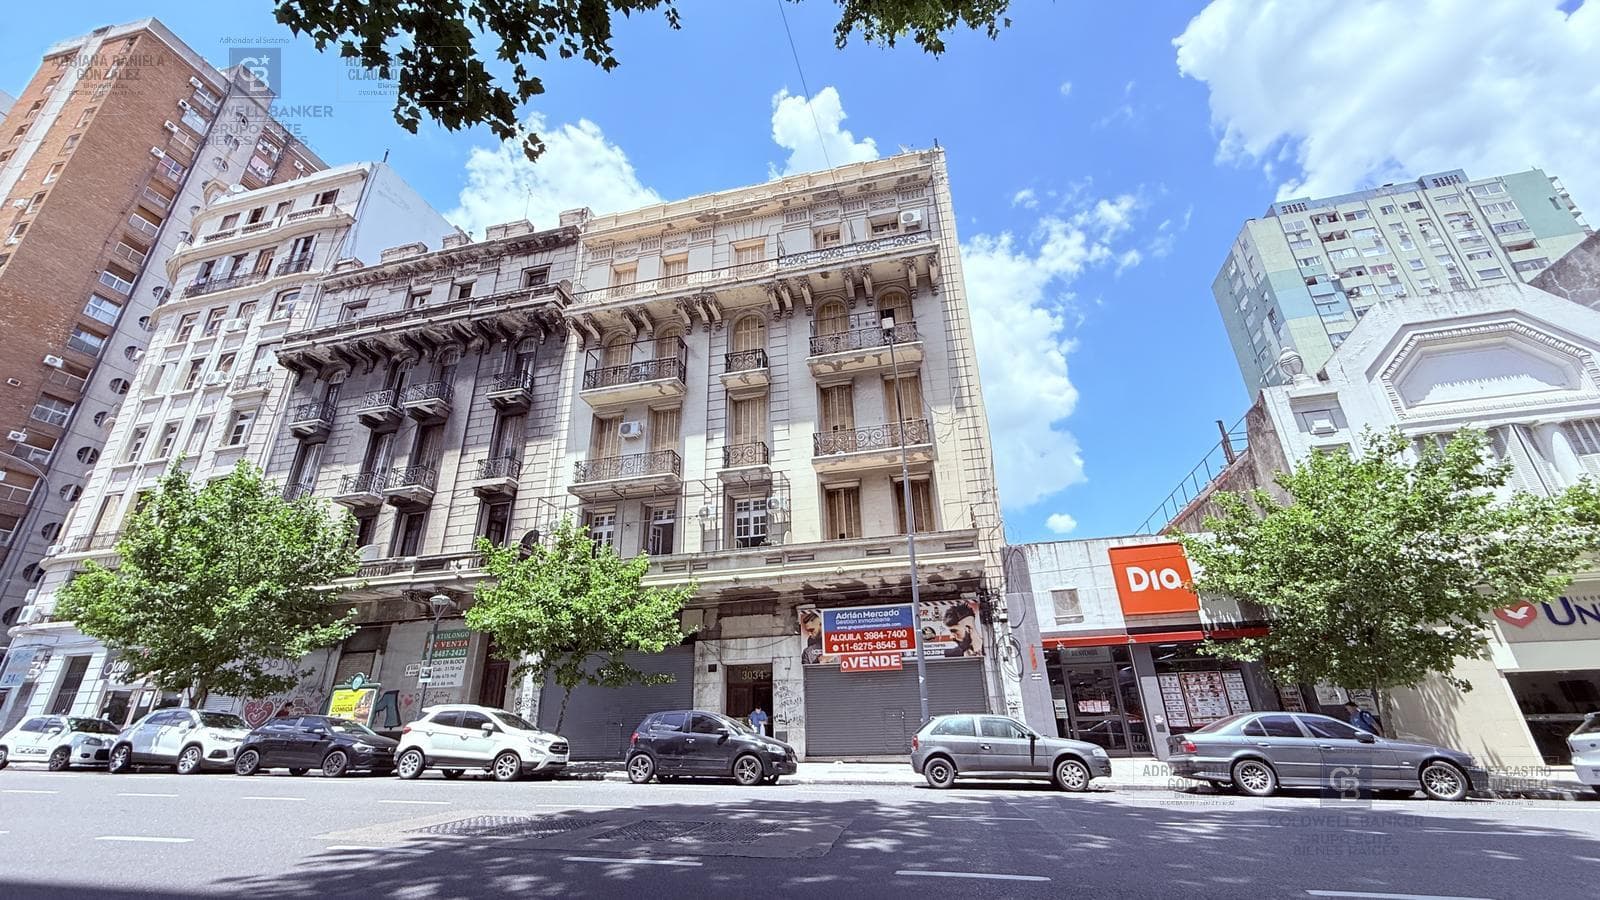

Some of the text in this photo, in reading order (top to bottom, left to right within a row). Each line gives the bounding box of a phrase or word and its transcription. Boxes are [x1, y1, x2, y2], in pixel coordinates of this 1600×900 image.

[835, 609, 900, 620] Adrián Mercado
[830, 629, 908, 642] ALQUILA 3984-7400
[440, 640, 469, 648] VENTA
[840, 640, 897, 651] 11-6275-8545
[848, 654, 901, 669] VENDE
[742, 670, 765, 680] 3034
